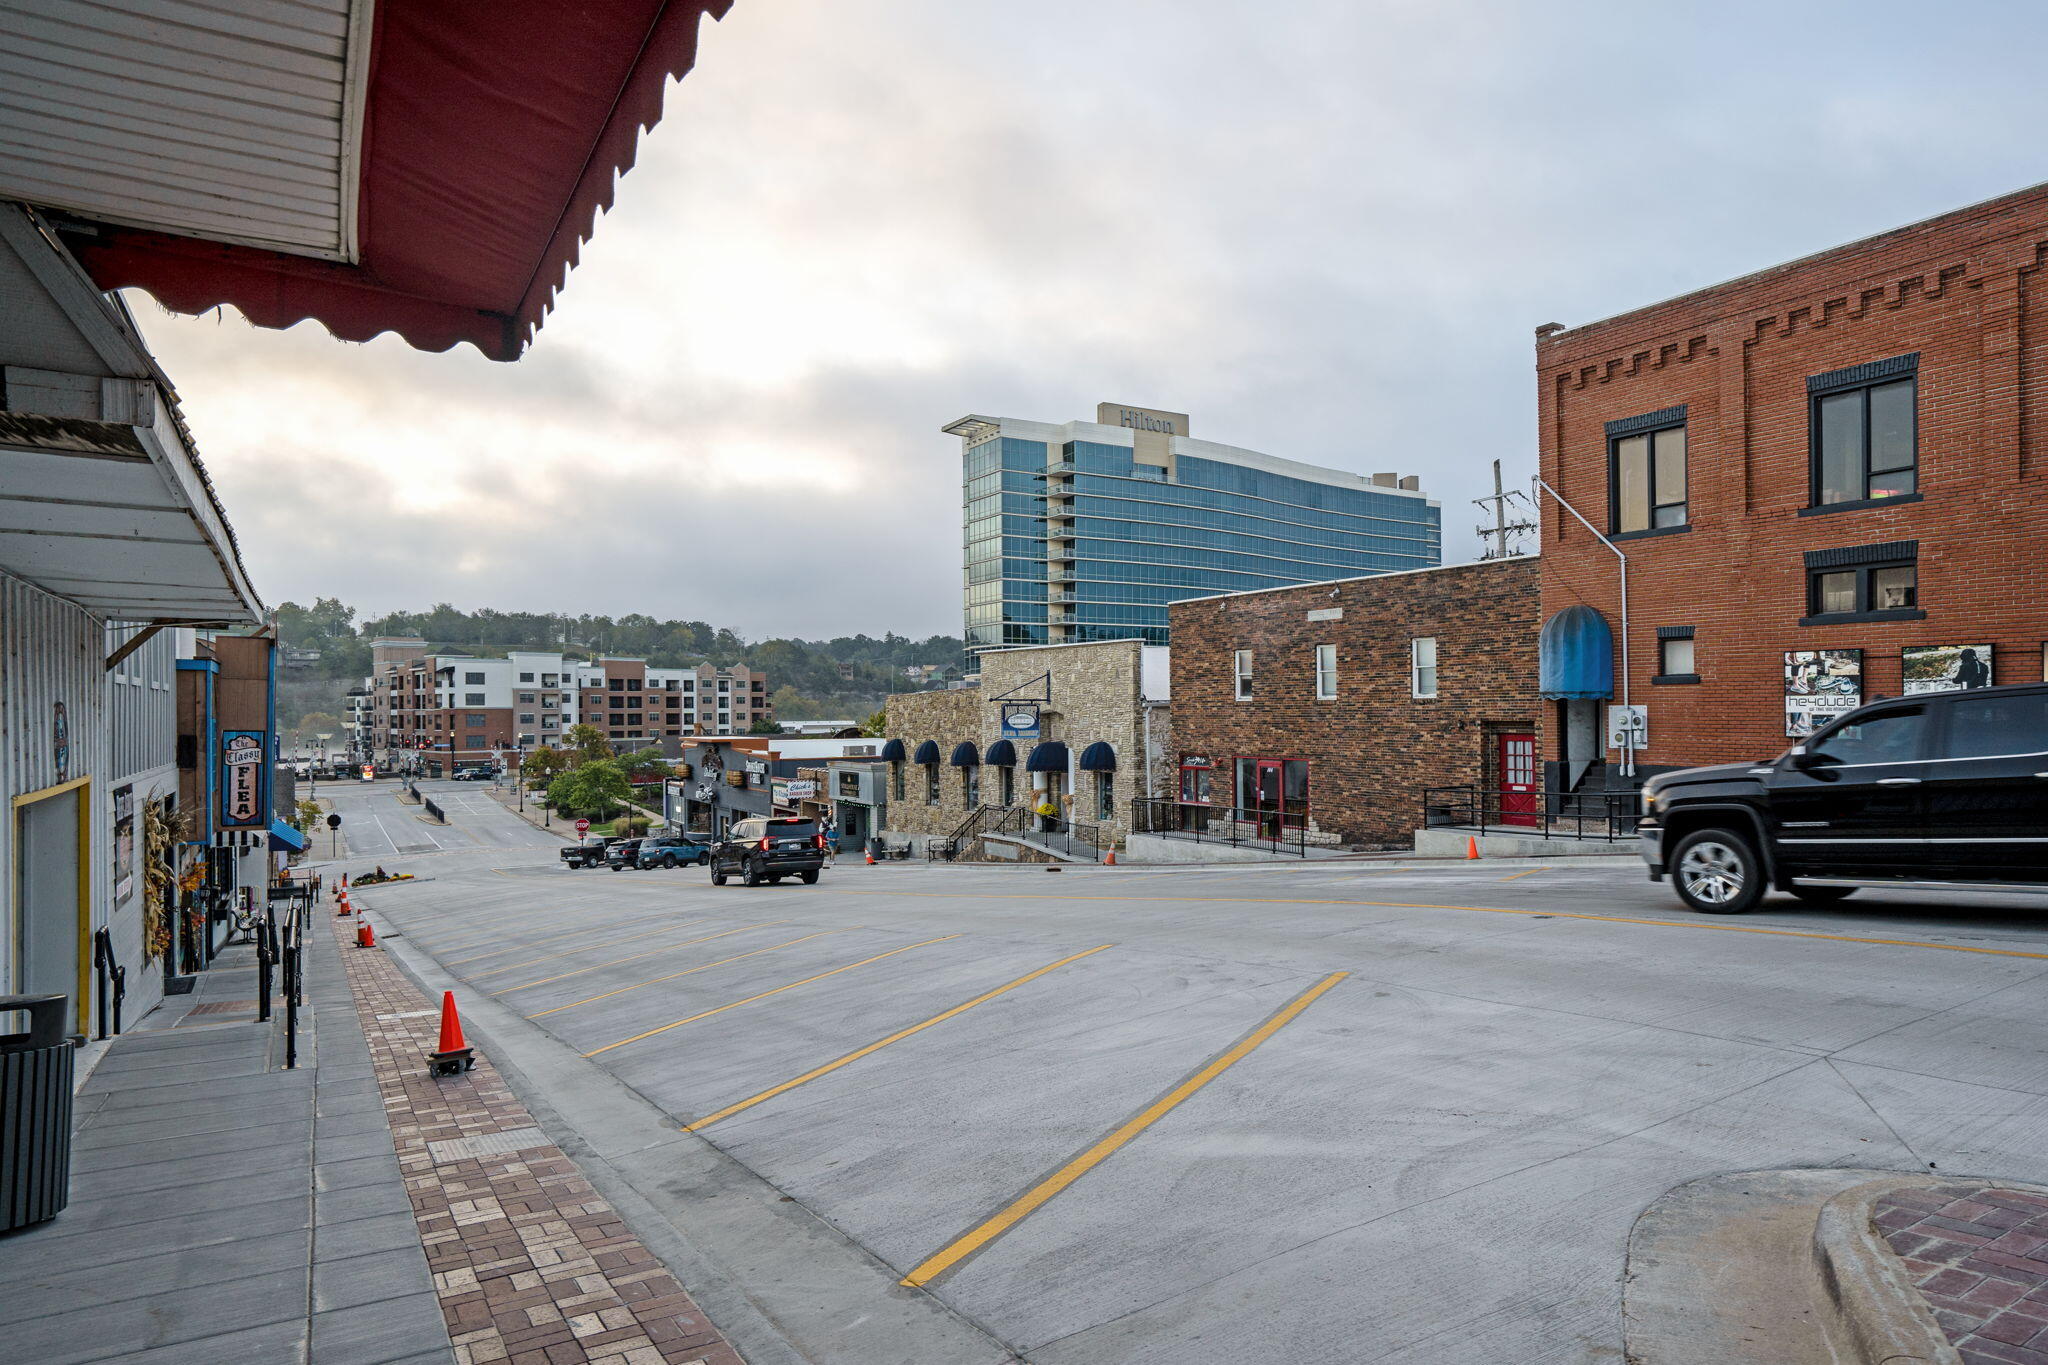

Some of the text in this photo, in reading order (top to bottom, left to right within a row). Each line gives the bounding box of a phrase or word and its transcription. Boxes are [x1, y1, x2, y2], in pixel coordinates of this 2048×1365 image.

[1120, 408, 1175, 434] Hilton
[1789, 695, 1856, 706] heydude
[235, 740, 248, 748] The
[226, 750, 260, 764] Classy
[237, 766, 250, 814] FLEA
[790, 783, 811, 791] Chick's
